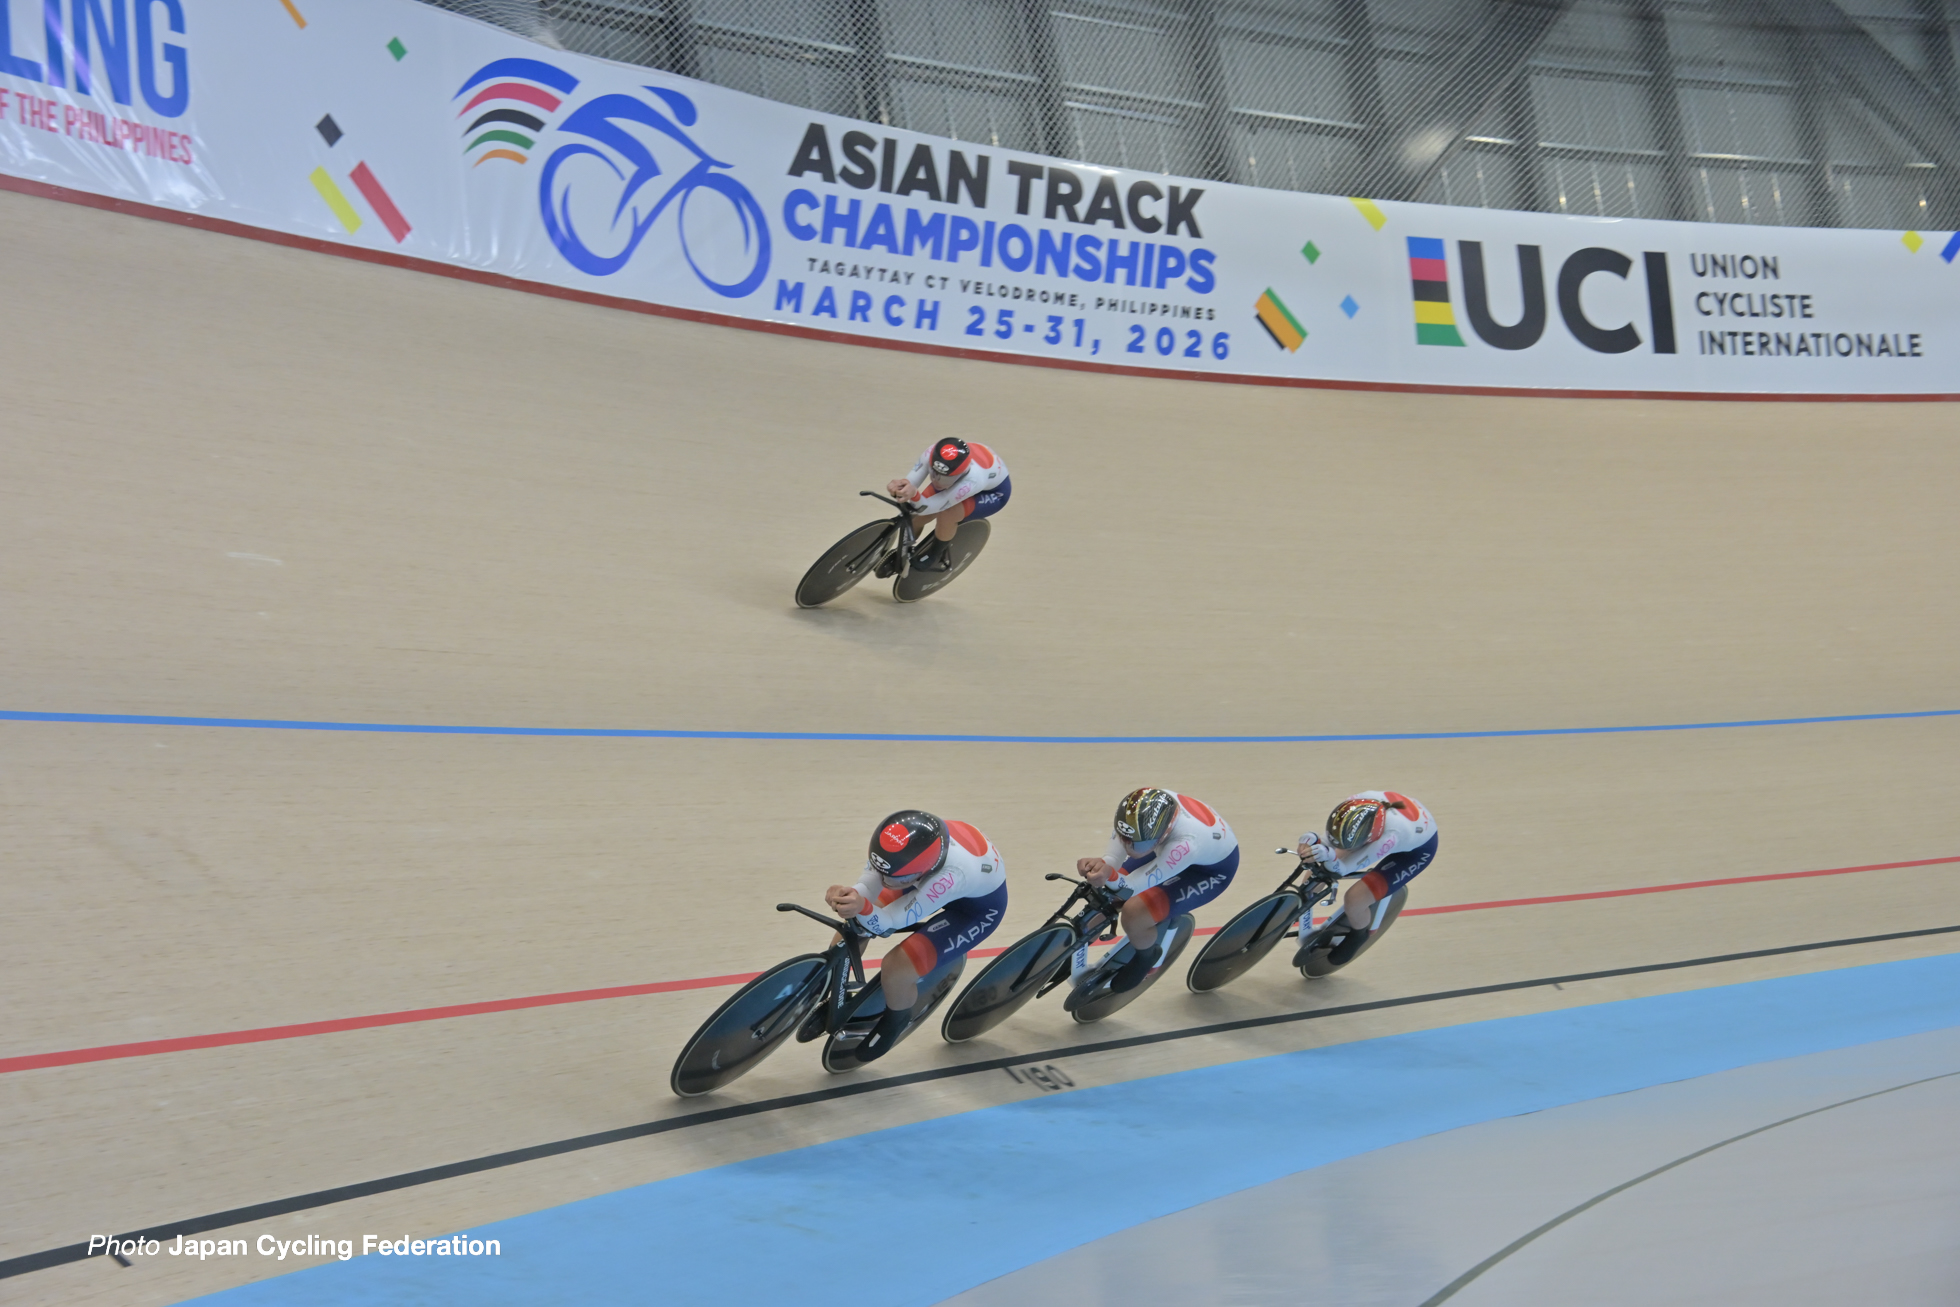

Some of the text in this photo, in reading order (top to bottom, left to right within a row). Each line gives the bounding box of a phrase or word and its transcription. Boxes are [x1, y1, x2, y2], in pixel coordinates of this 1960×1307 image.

[14, 92, 59, 133] THE
[64, 104, 193, 165] PHILIPPINES
[788, 122, 1206, 239] ASIAN TRACK
[782, 188, 1217, 294] CHAMPIONSHIPS
[1690, 253, 1780, 280] UNION
[808, 258, 1216, 322] TAGAYTAY CT VELODROME, PHILIPPINES
[1457, 240, 1678, 355] UCI
[1695, 292, 1815, 319] CYCLISTE
[775, 279, 1231, 361] MARCH 25-31, 2026
[1699, 331, 1924, 358] INTERNATIONALE
[1176, 873, 1227, 903] JAPAN
[1392, 852, 1431, 885] JAPAN
[943, 908, 999, 953] JAPAN
